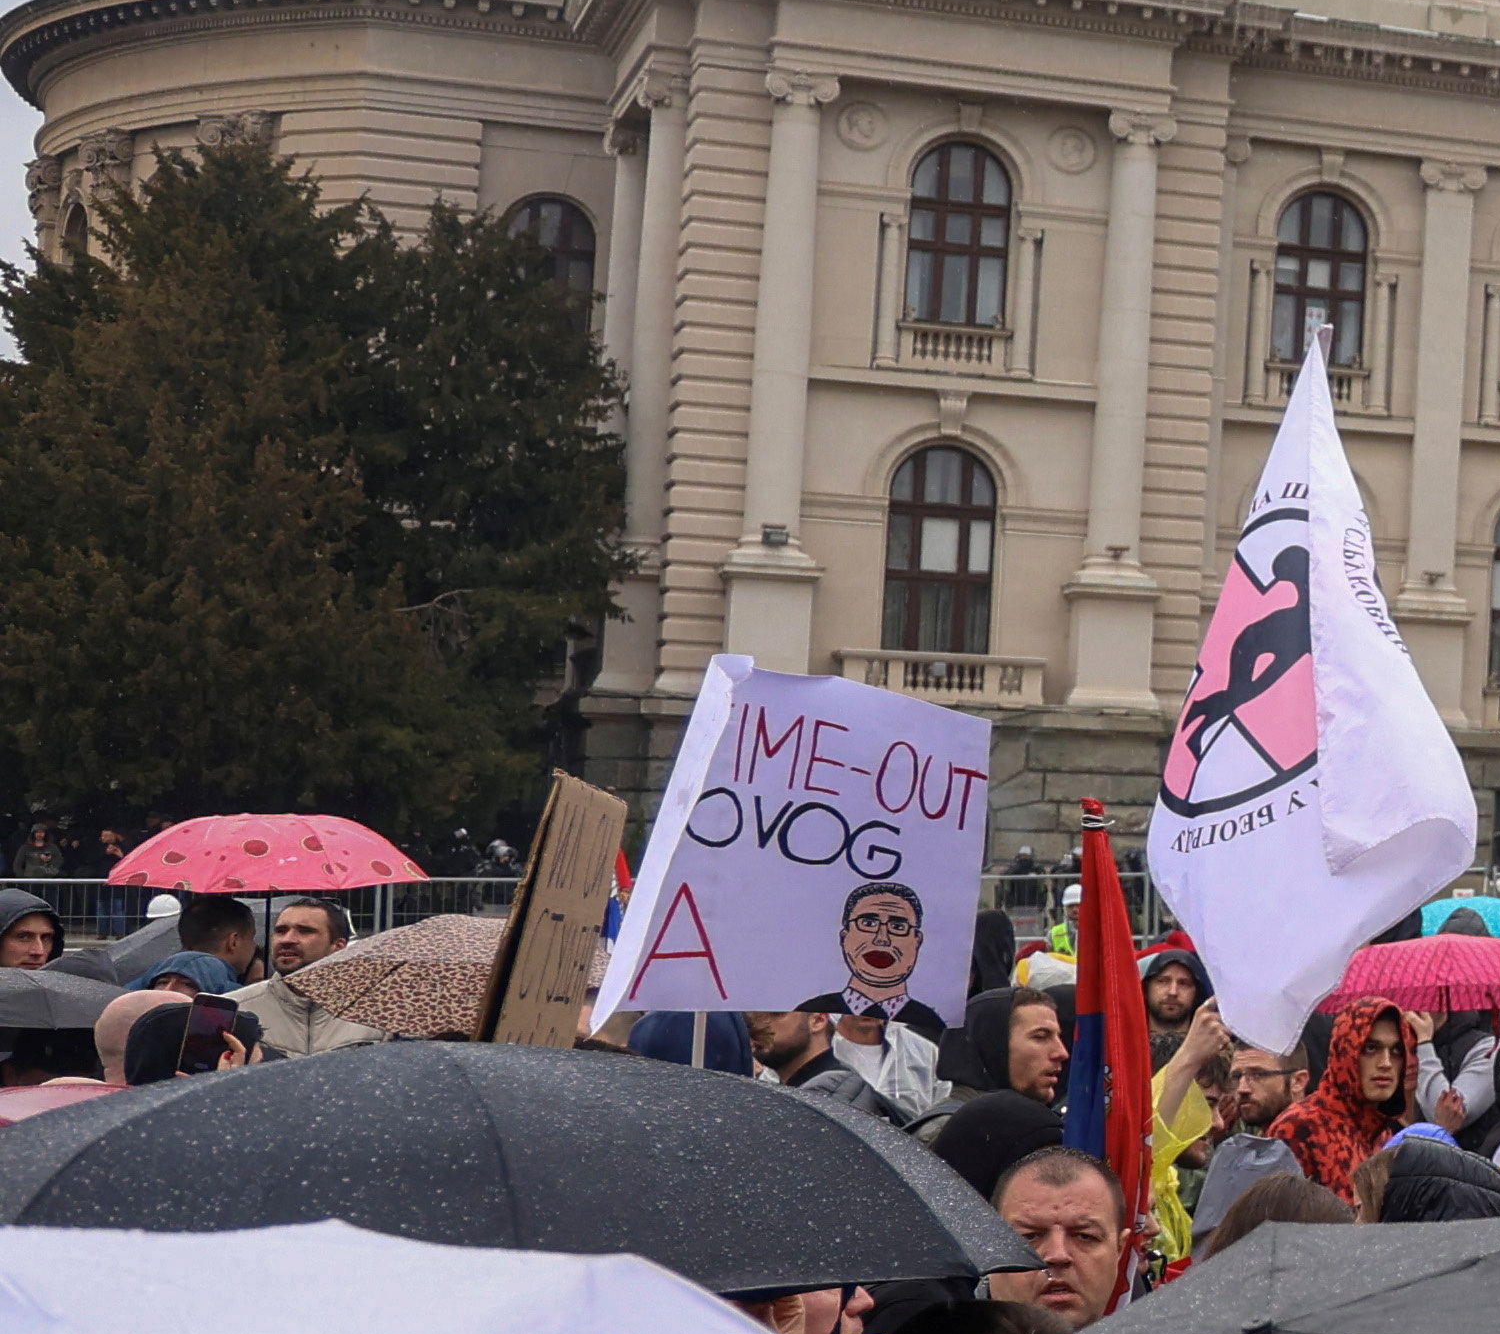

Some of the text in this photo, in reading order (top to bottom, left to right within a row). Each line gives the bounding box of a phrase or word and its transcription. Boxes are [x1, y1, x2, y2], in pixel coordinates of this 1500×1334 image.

[731, 703, 988, 830] IME-OUT
[686, 786, 902, 880] OVOG
[629, 882, 728, 1000] A
